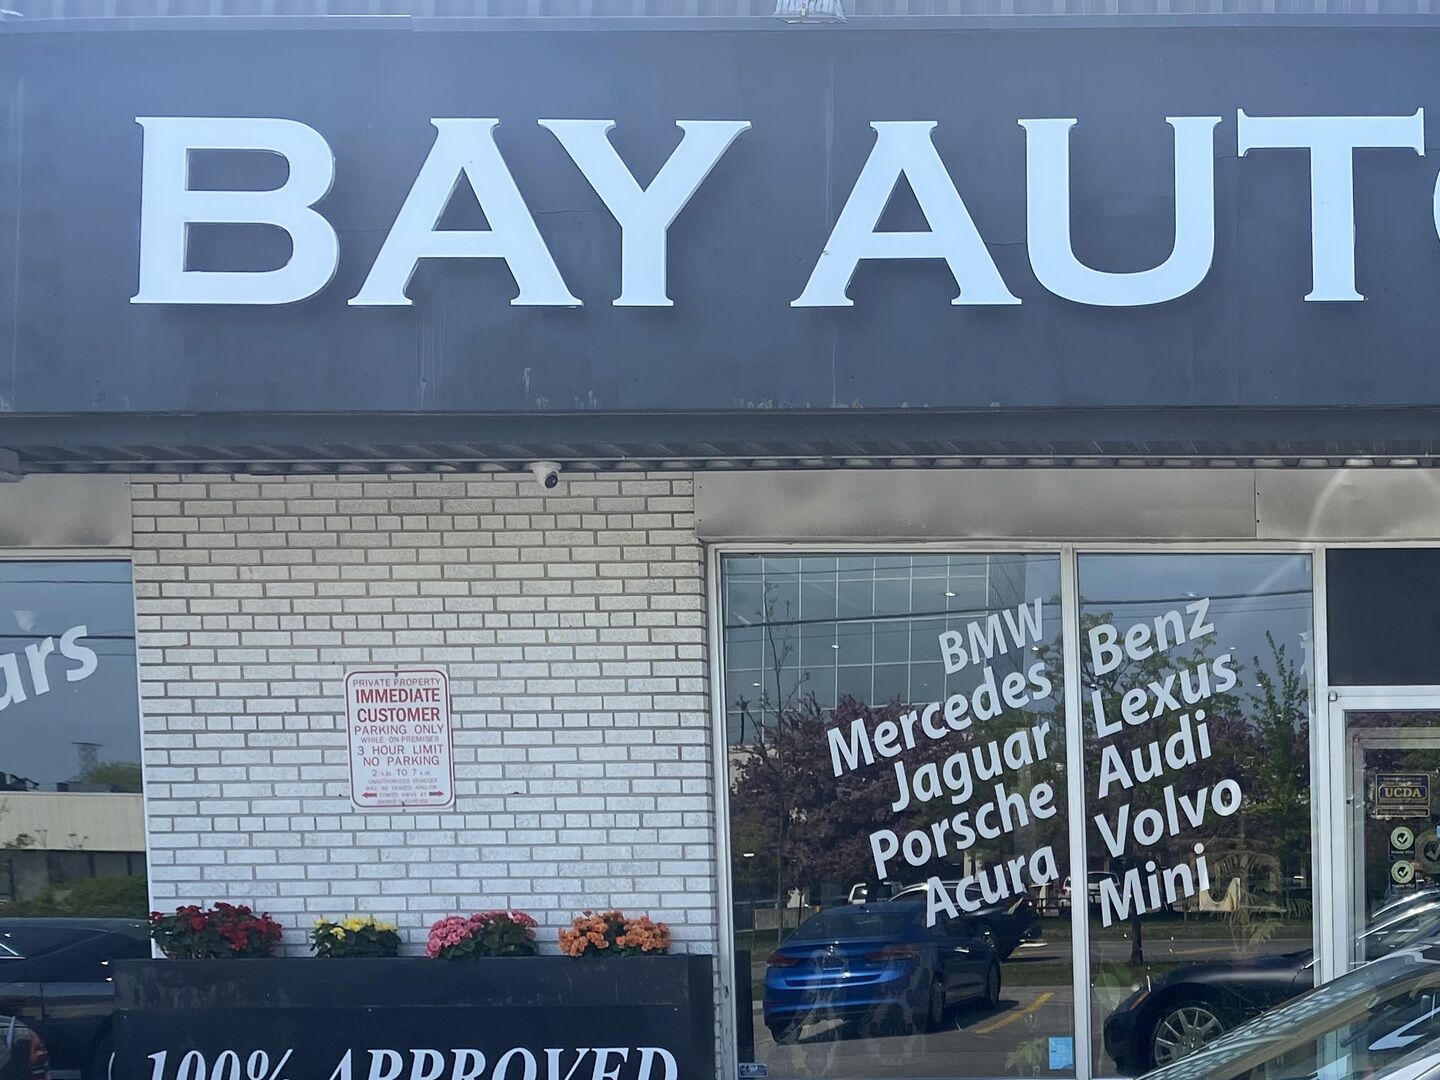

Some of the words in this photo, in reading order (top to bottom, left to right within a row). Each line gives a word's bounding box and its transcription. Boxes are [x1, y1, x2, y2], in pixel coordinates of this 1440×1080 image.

[130, 116, 752, 308] BAY
[939, 597, 1044, 675] BMW
[353, 679, 390, 687] PRIVATE
[394, 677, 441, 687] PROPERTY
[356, 688, 440, 703] IMMEDIATE
[357, 707, 440, 723] CUSTOMER
[827, 661, 1052, 777] Mercedes
[1088, 597, 1215, 676] Benz
[1091, 653, 1237, 738] Lexus
[354, 725, 407, 735] PARKING
[414, 724, 444, 734] ONLY
[357, 746, 365, 756] 3
[372, 745, 405, 755] HOUR
[413, 744, 444, 755] LIMIT
[363, 757, 380, 767] NO
[387, 755, 440, 766] PARKING
[891, 721, 1050, 813] Jaguar
[1098, 709, 1212, 799] Audi
[869, 779, 1057, 879] Porsche
[1094, 779, 1242, 858] Volvo
[1385, 787, 1422, 798] UCDA
[925, 845, 1059, 928] Acura
[1098, 843, 1210, 928] Mini
